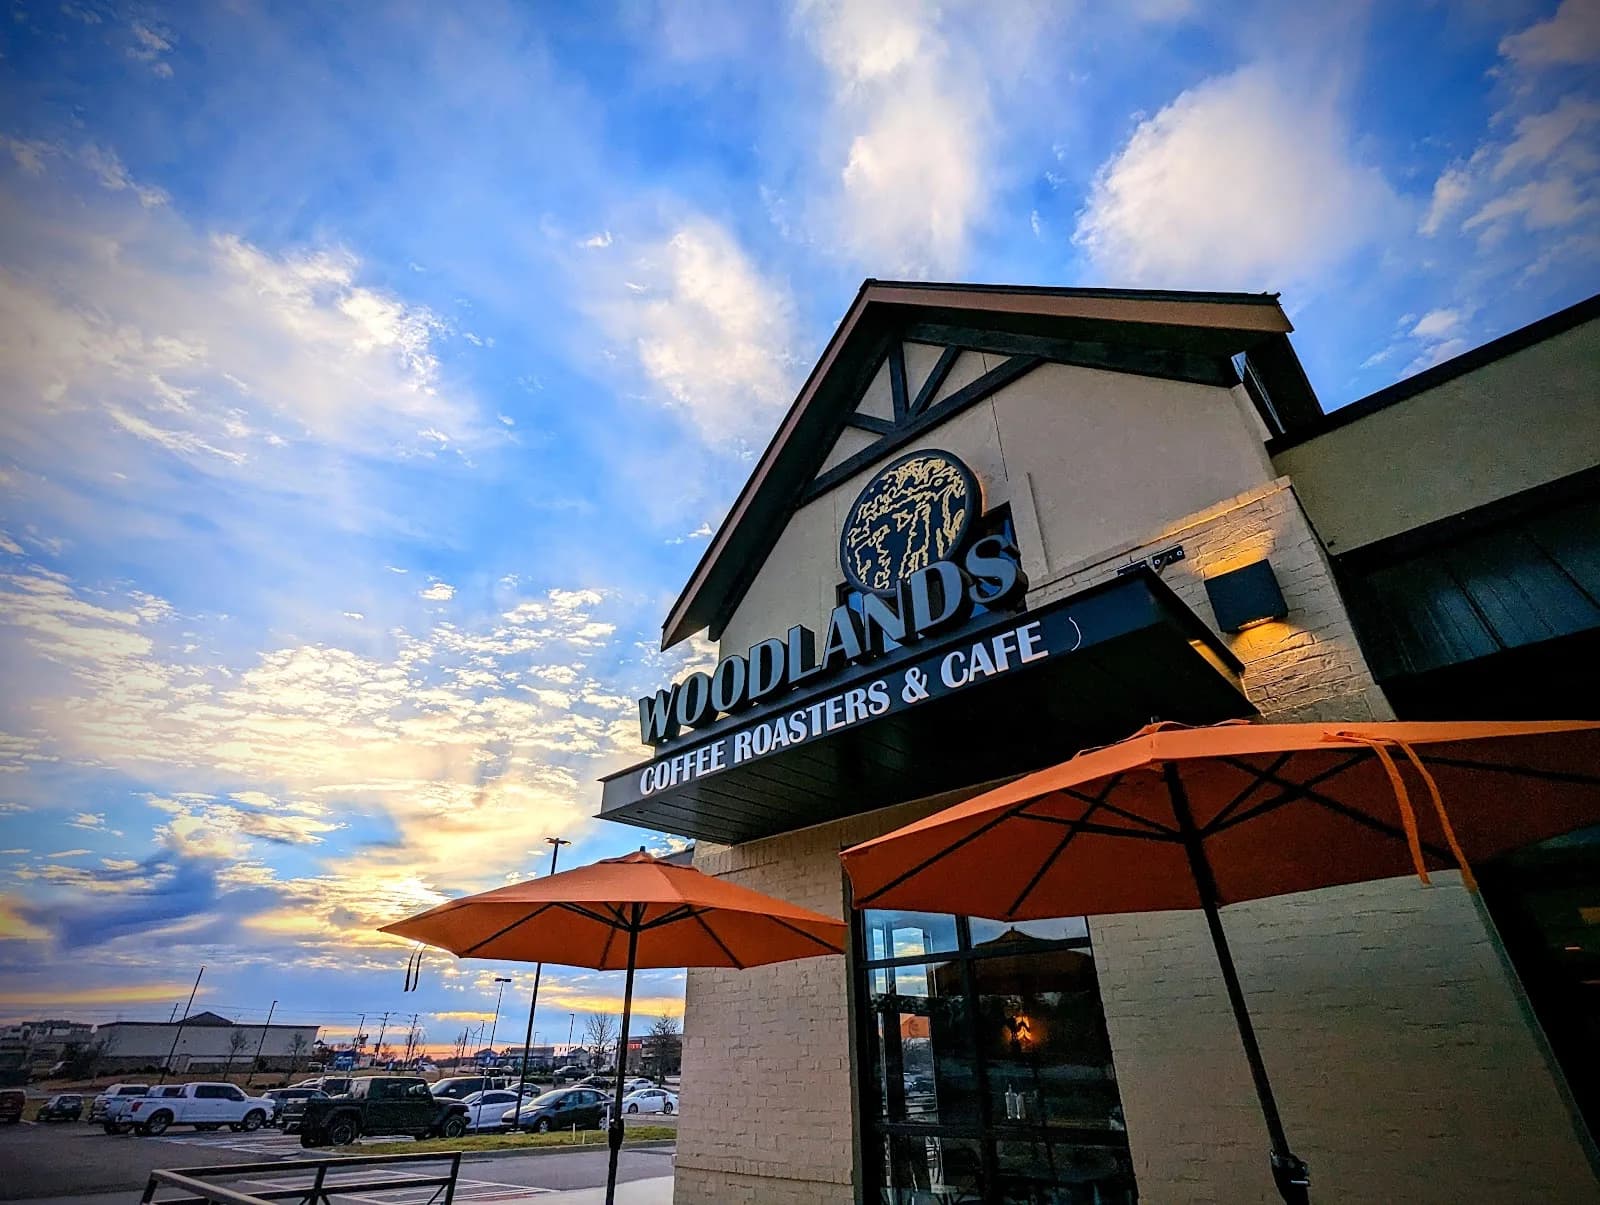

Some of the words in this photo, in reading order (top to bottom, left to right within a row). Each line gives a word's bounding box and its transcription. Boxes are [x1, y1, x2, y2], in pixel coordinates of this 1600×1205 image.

[639, 535, 1022, 744] WOODLANDS
[640, 740, 726, 795] COFFEE
[735, 681, 889, 764] ROASTERS
[902, 667, 929, 704] &
[941, 622, 1049, 689] CAFE
